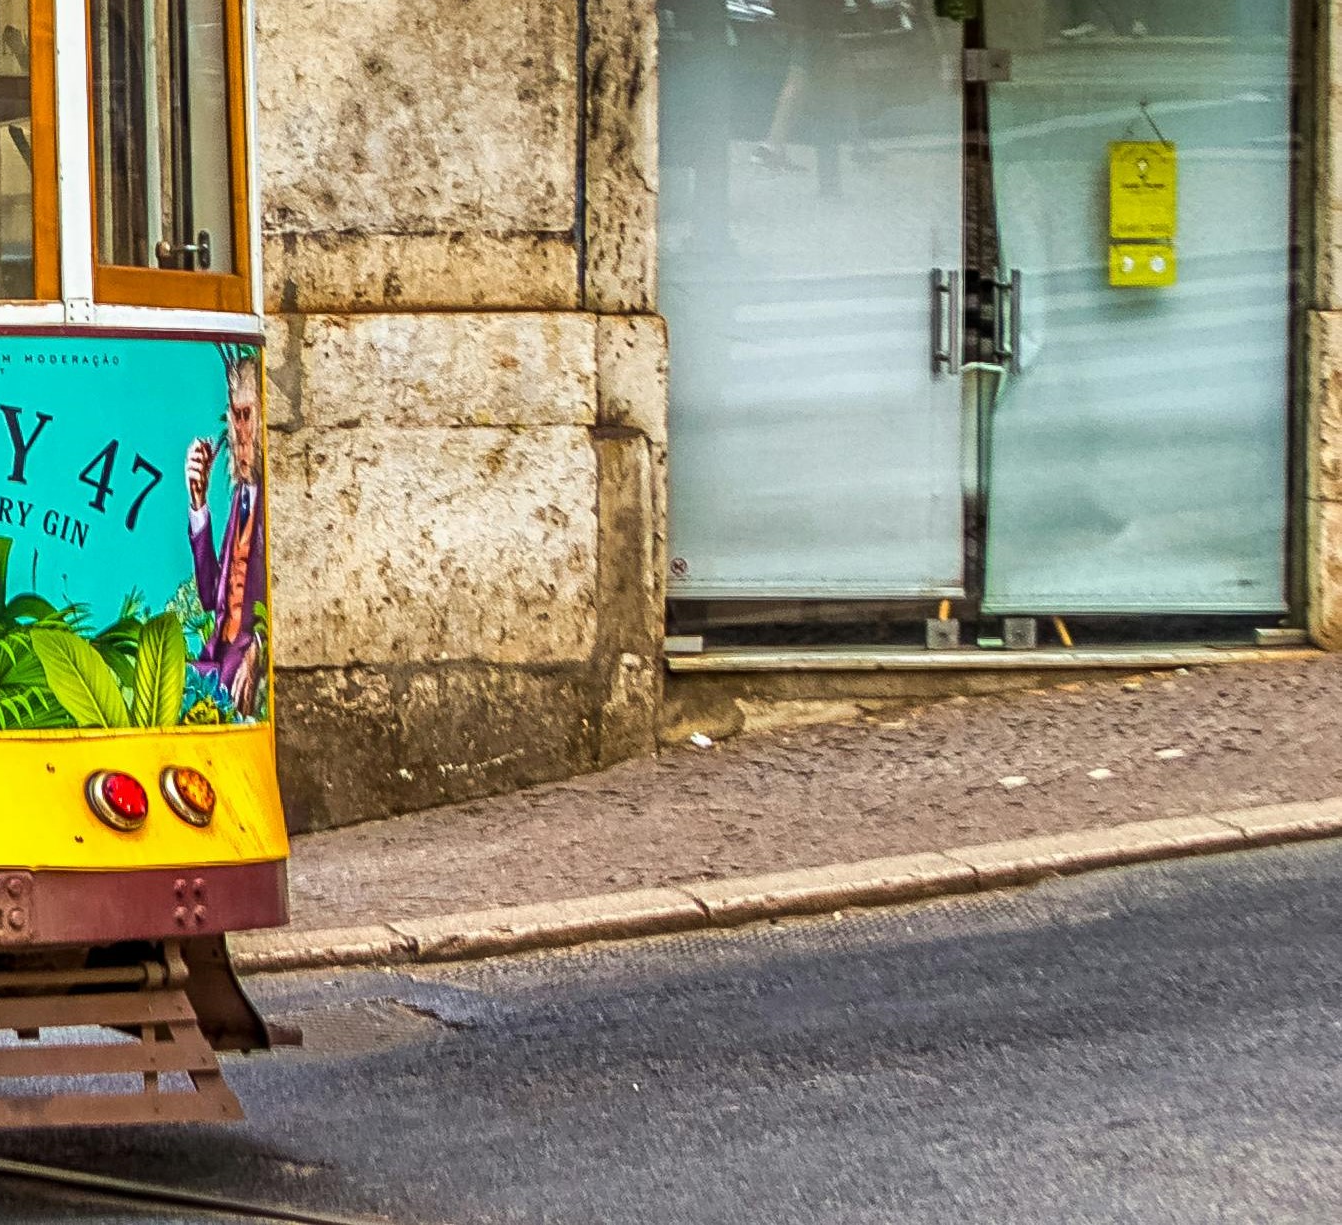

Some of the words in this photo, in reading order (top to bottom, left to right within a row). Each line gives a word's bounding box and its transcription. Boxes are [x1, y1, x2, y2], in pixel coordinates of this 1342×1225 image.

[24, 353, 121, 367] MODERAÇÃO
[78, 438, 164, 533] 47
[42, 508, 91, 549] GIN
